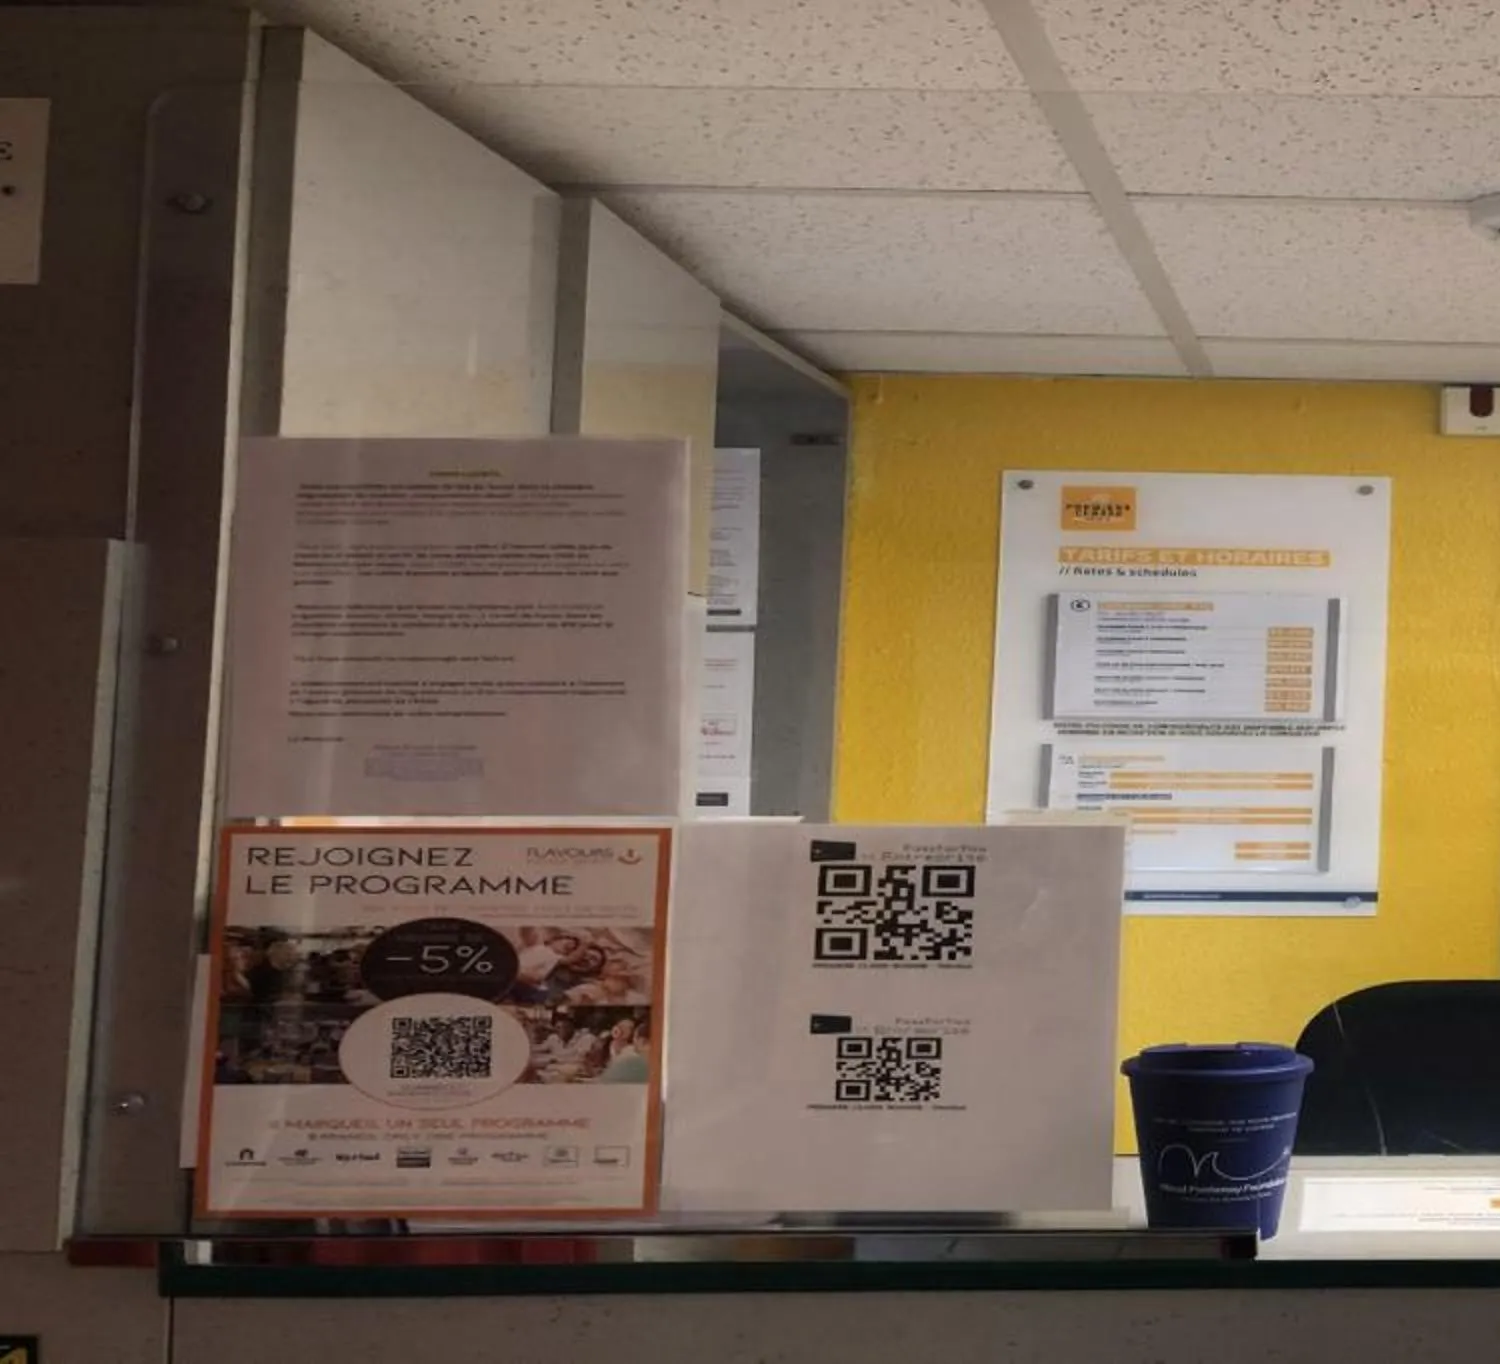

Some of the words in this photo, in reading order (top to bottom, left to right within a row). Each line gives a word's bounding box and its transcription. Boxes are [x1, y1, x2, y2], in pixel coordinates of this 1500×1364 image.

[1065, 547, 1151, 563] TARIFS
[1158, 549, 1188, 563] ET
[1197, 550, 1326, 565] HORAIRES
[1129, 567, 1198, 578] schedules
[246, 847, 474, 868] REJOIGNEZ
[244, 875, 293, 895] LE
[308, 875, 575, 896] PROGRAMME
